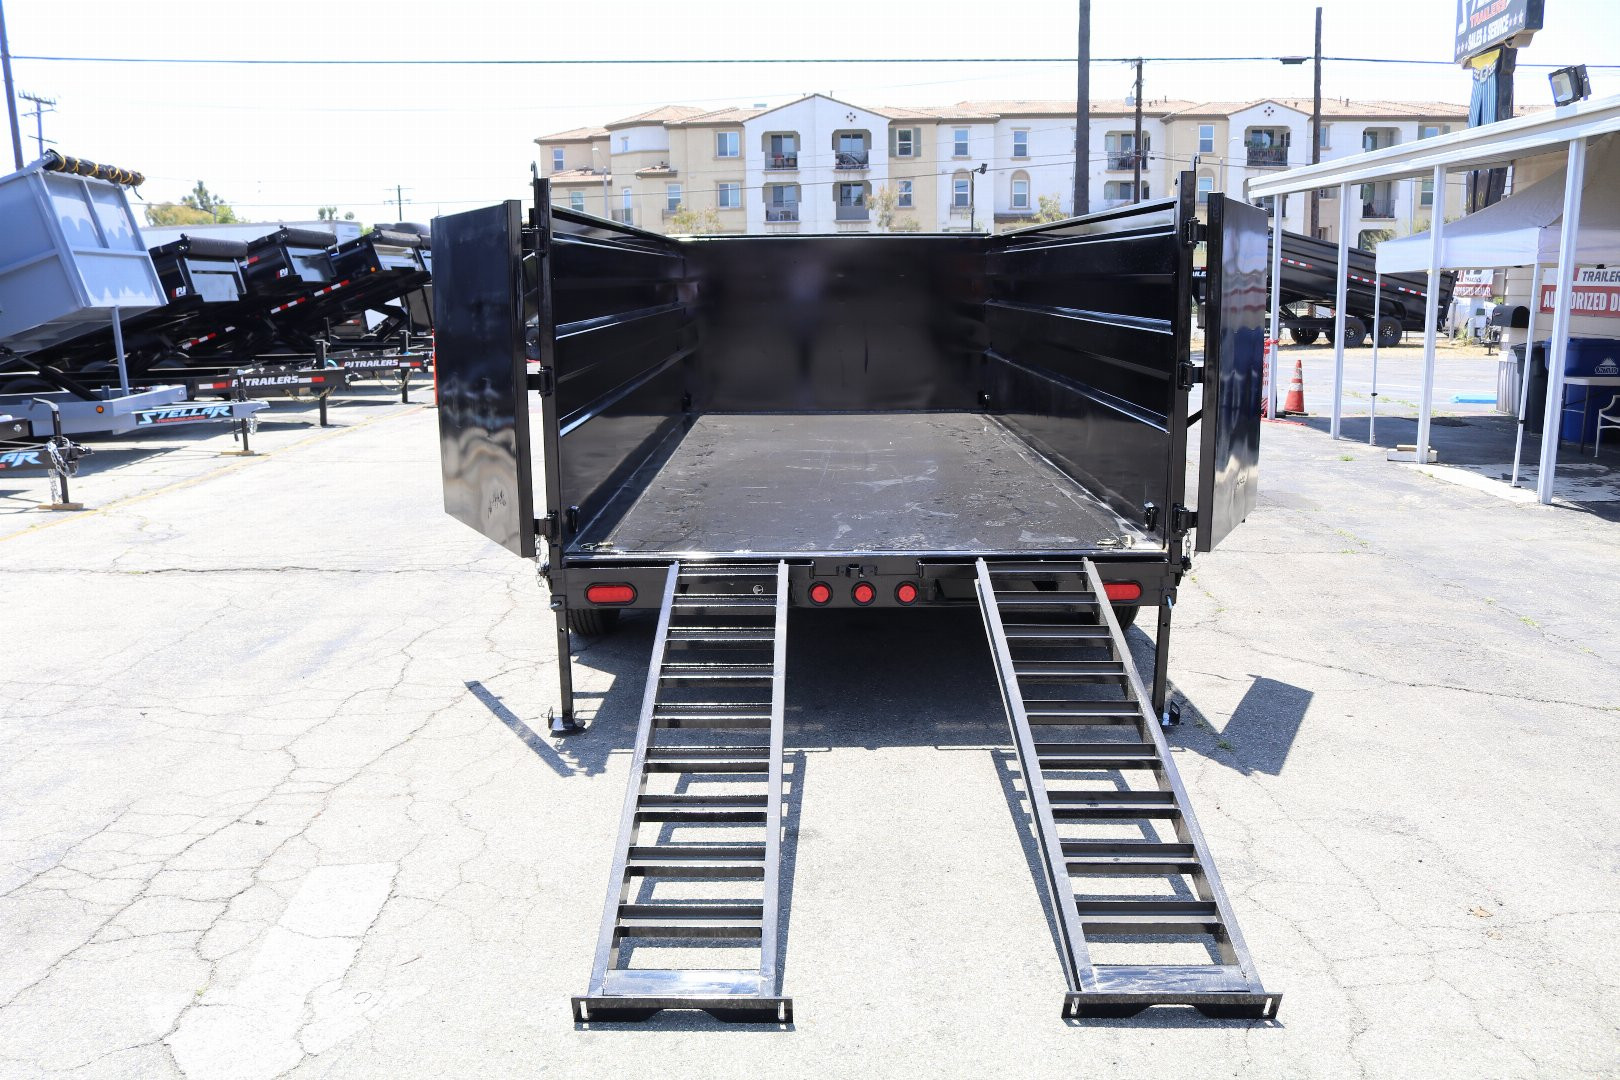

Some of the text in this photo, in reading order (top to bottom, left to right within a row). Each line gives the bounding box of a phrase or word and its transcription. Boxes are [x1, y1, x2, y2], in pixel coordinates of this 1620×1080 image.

[1467, 28, 1483, 52] SALES
[1488, 13, 1510, 42] SERVICE
[1543, 290, 1607, 311] AUORIZED
[356, 359, 399, 368] TRAILERS
[245, 375, 299, 387] TRAILERS
[138, 405, 233, 425] STELLAR
